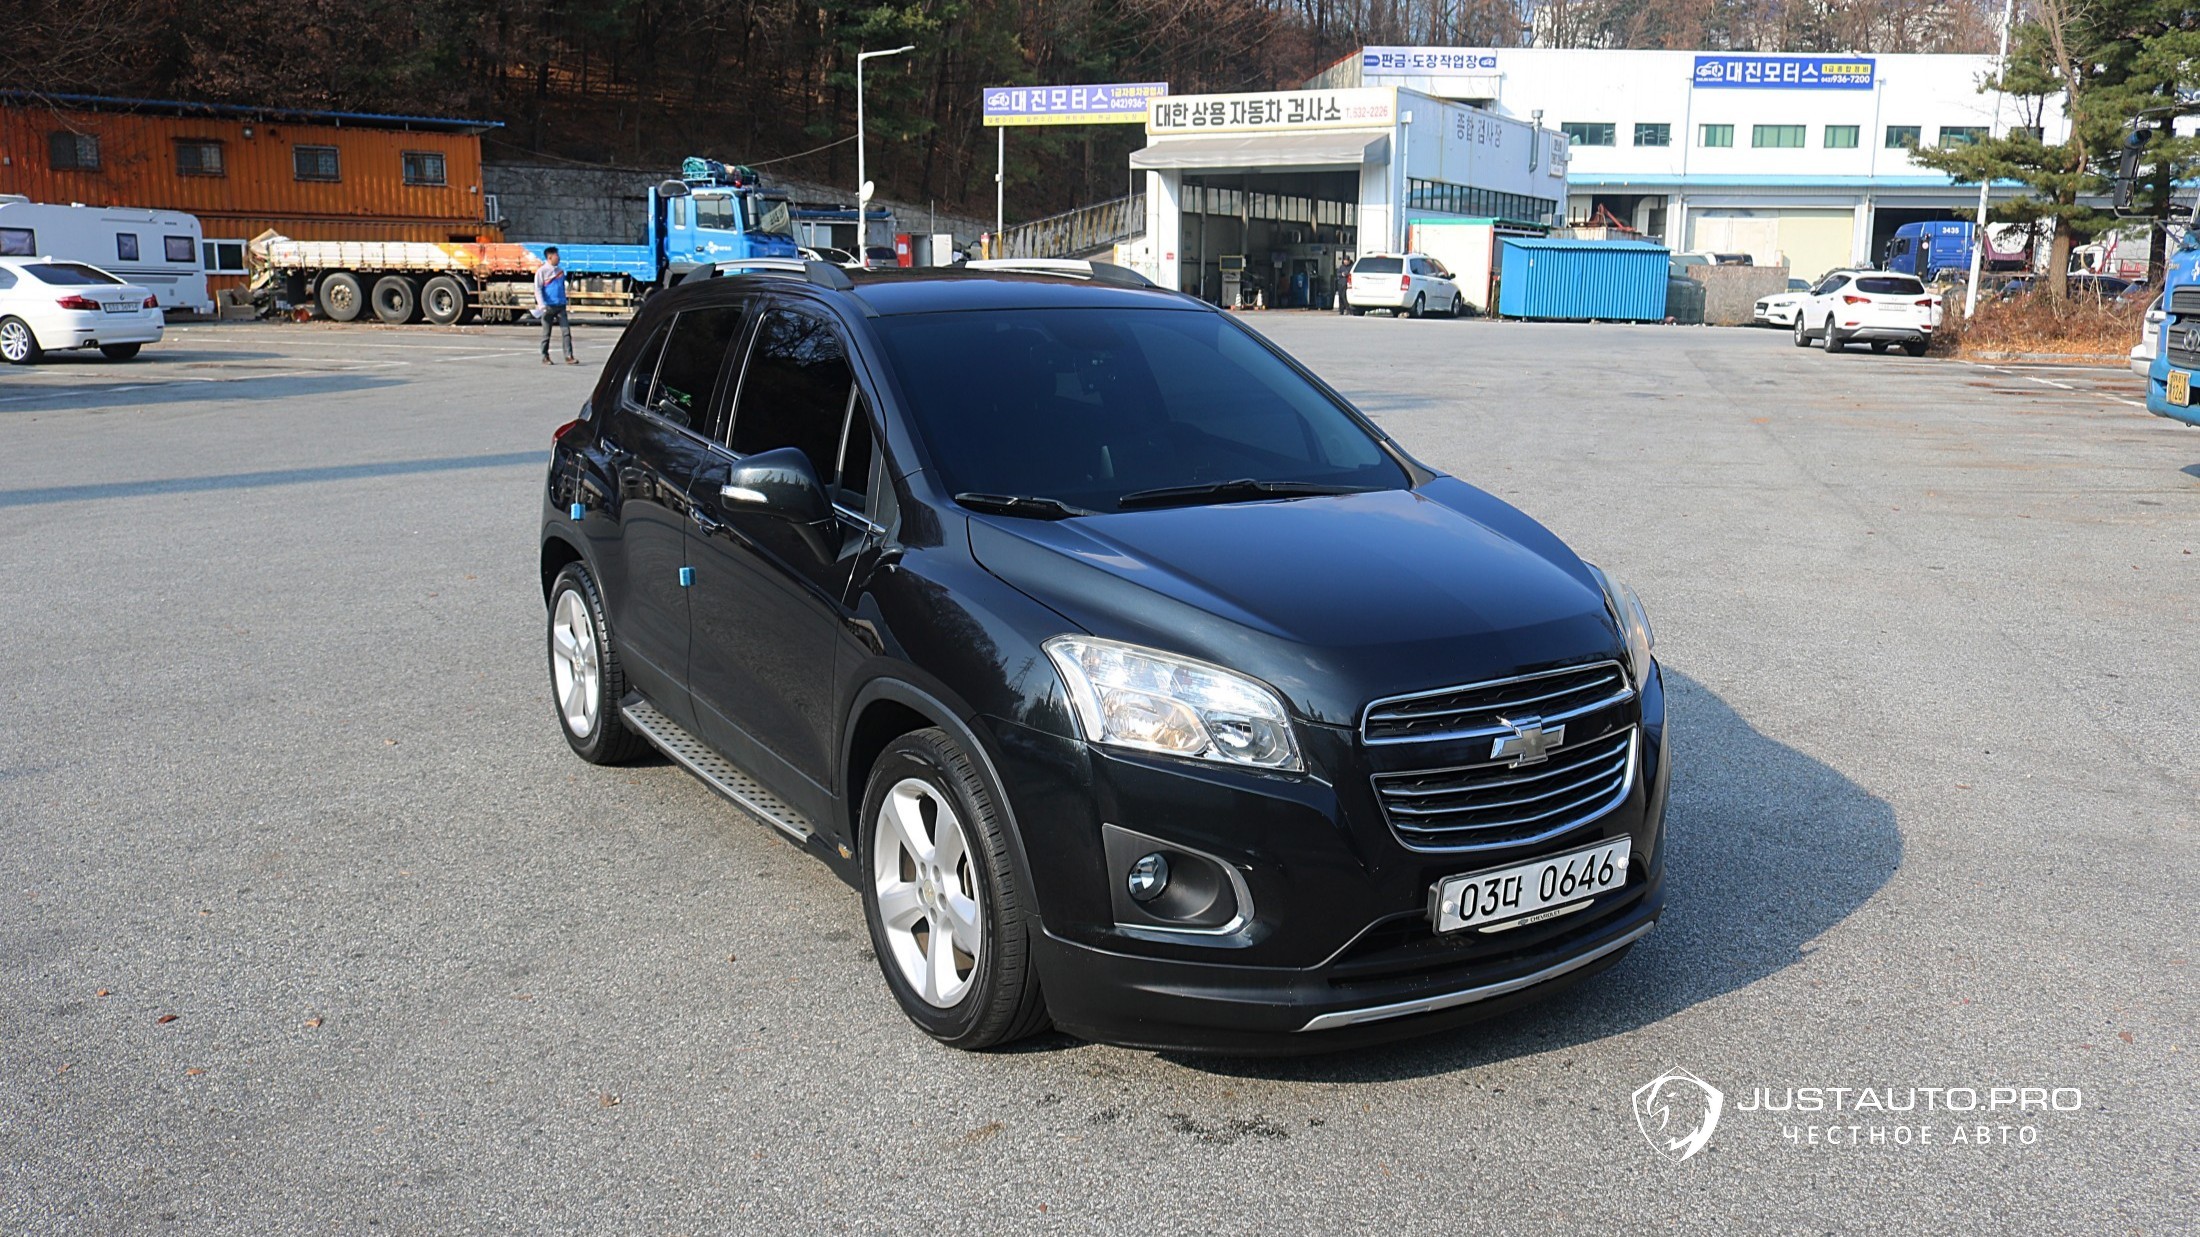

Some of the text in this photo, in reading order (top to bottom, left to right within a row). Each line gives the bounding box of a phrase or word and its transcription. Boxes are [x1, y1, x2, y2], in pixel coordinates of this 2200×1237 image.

[1440, 54, 1478, 69] 작업장
[1725, 61, 1819, 83] 대진모터스
[1011, 88, 1108, 112] 대진모터스
[1155, 96, 1341, 127] 대한 상용 자동차 검사소
[1478, 119, 1502, 148] 검사장
[1459, 850, 1614, 921] 03다 0646
[1530, 910, 1560, 923] CHEVROLET
